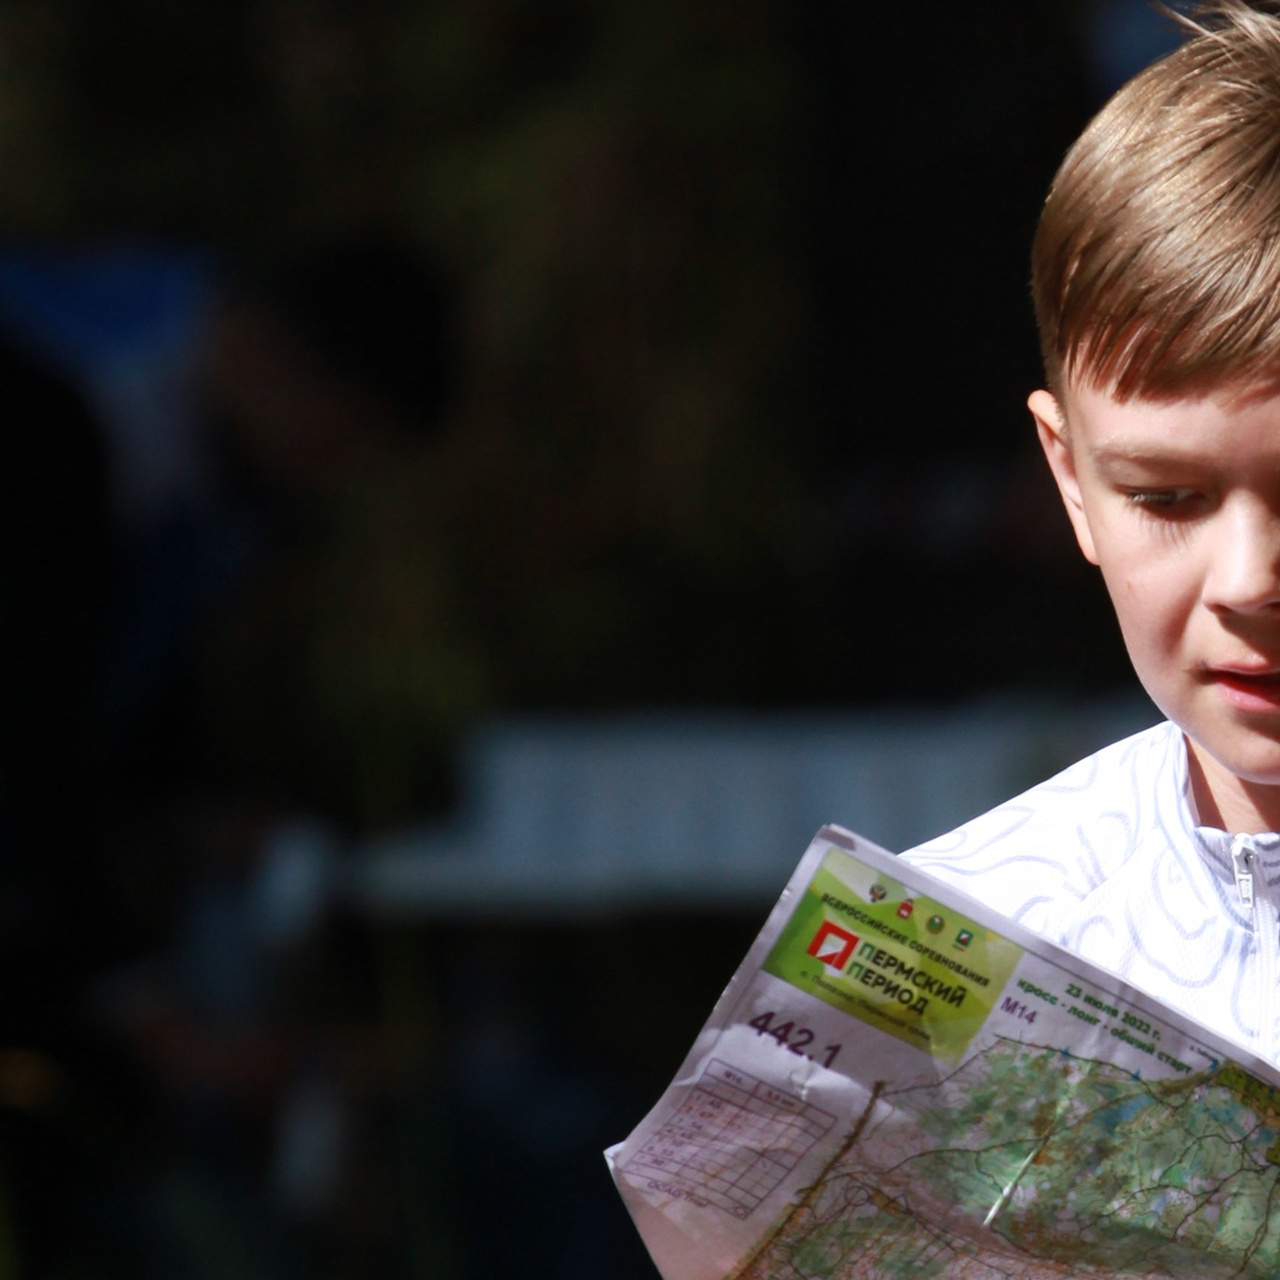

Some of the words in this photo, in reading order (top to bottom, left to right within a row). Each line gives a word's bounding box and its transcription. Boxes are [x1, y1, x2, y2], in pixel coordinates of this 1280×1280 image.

[821, 893, 908, 945] ВСЕРОССИЙСКИЕ
[909, 939, 989, 988] СОРЕВНОВАНИЯ
[847, 961, 928, 1016] ПЕРИОД
[858, 942, 967, 1008] ПЕРМСКИЙ
[1001, 996, 1037, 1025] М14
[1017, 979, 1059, 1006] кросс
[1068, 1006, 1101, 1026] лонг
[1110, 1027, 1155, 1055] общий
[1157, 1051, 1192, 1074] старт
[1065, 983, 1082, 998] 23
[1083, 994, 1119, 1018] июля
[1121, 1012, 1151, 1036] 2022
[749, 1011, 842, 1069] 442.1
